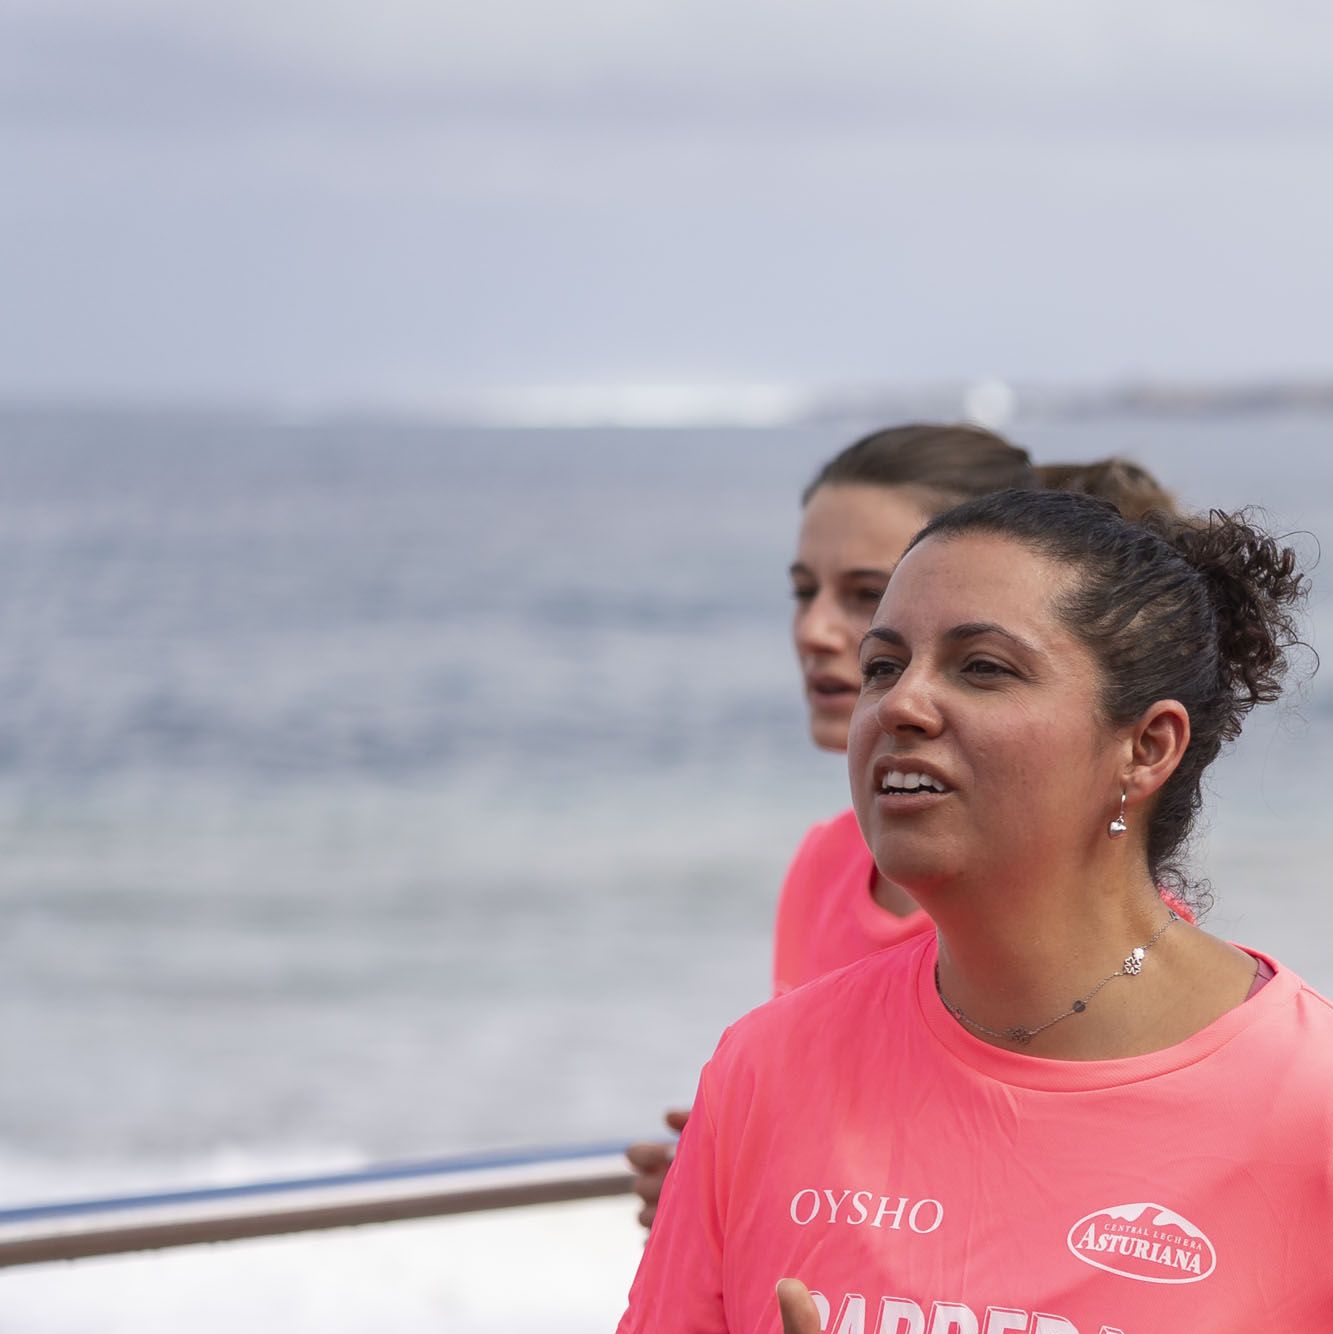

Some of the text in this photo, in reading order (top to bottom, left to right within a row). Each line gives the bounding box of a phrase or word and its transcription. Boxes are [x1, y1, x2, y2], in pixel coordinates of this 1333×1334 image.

[790, 1189, 944, 1234] OYSHO
[1075, 1223, 1201, 1275] ASTURIANA
[1104, 1223, 1202, 1251] CENTRAL LECHERA
